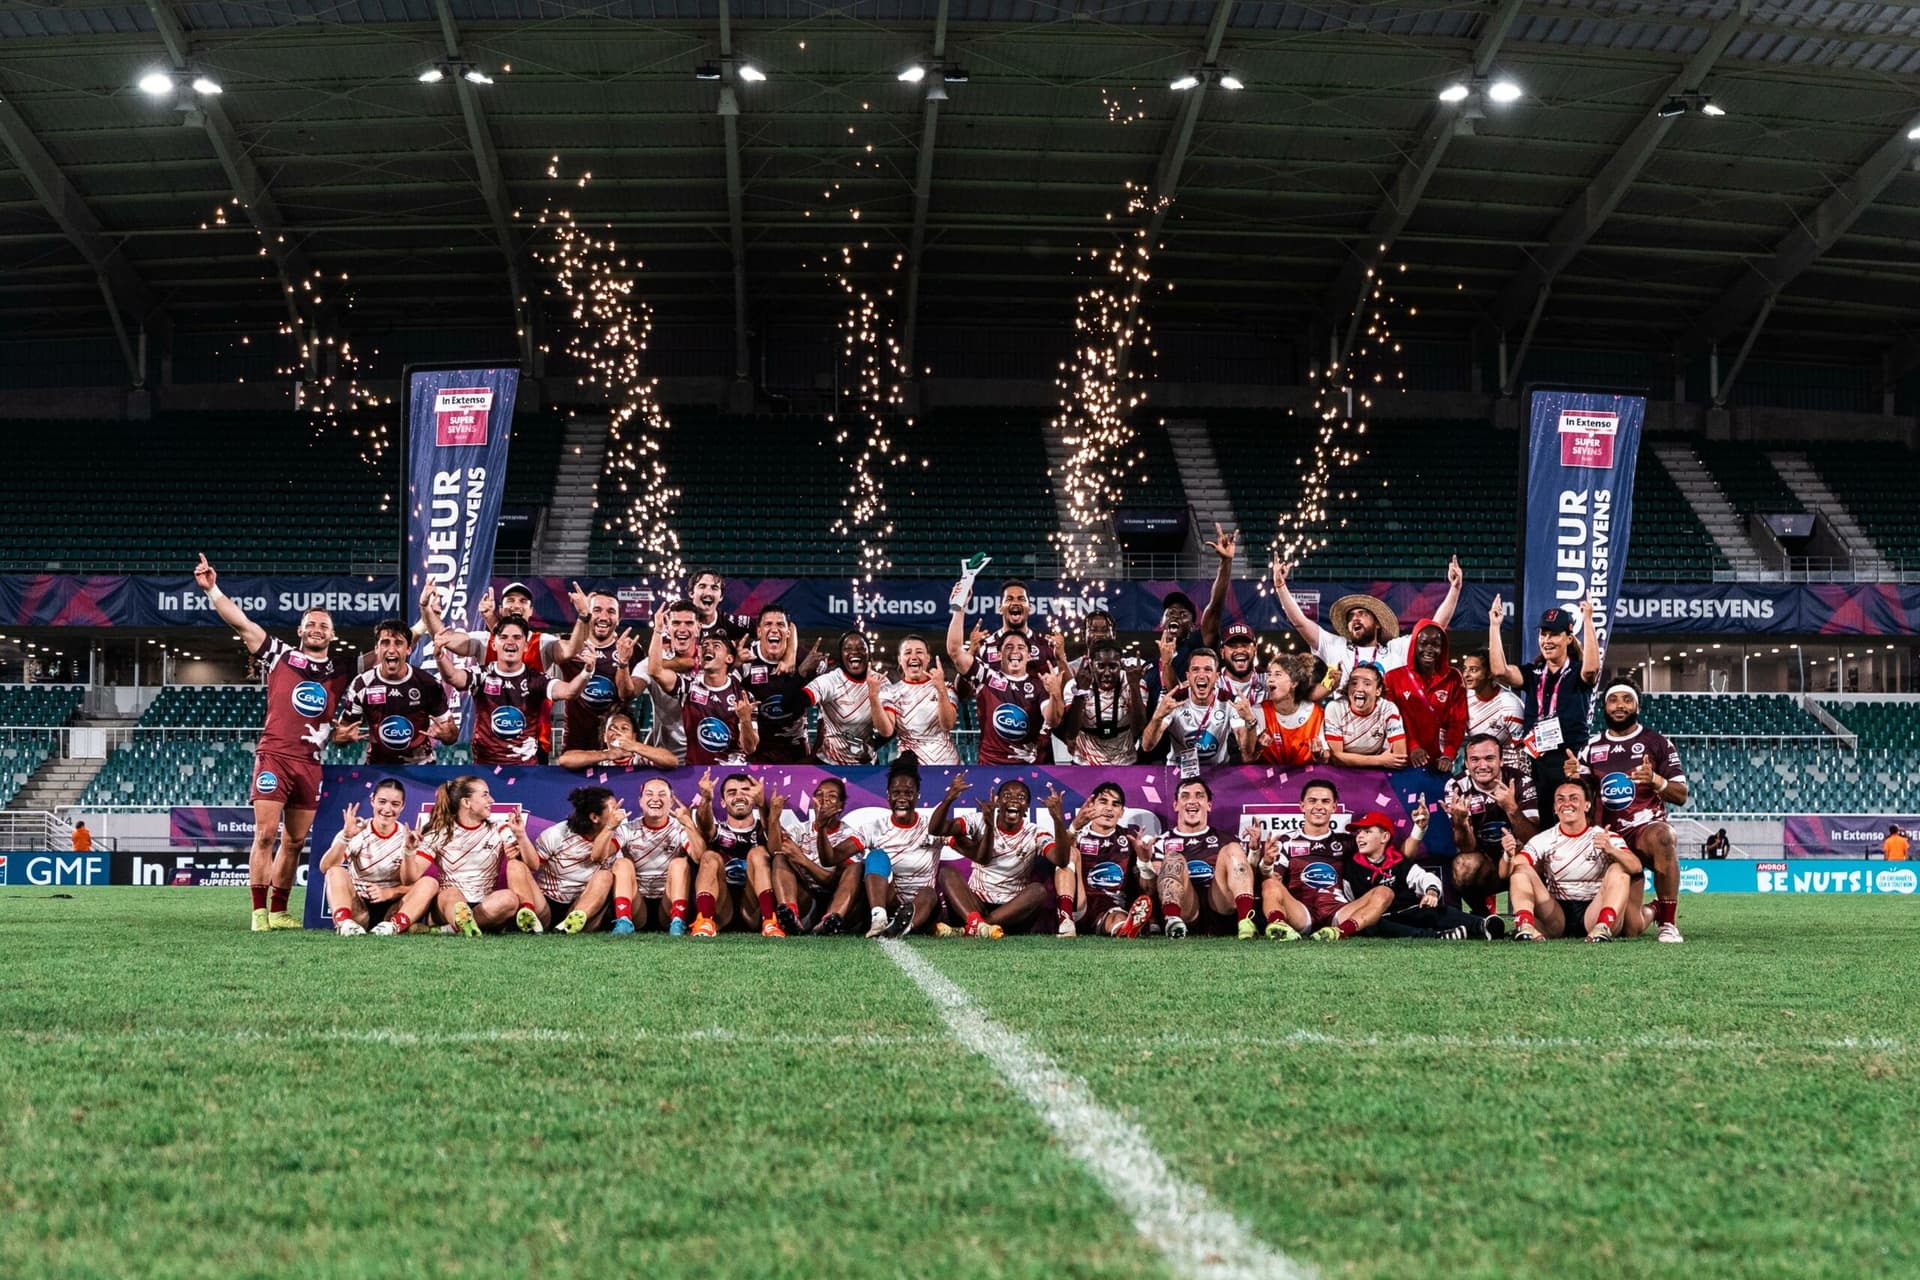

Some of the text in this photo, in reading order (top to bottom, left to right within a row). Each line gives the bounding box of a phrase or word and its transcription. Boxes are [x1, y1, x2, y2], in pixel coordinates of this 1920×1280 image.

[442, 396, 486, 405] In Extenso
[449, 416, 475, 425] SUPER
[1566, 418, 1612, 428] In Extenso
[1574, 438, 1601, 447] SUPER
[158, 591, 178, 611] In
[279, 592, 400, 612] SUPERSEV
[829, 595, 848, 613] In
[853, 596, 937, 614] Extenso
[1615, 598, 1775, 619] SUPERSEVENS
[1229, 625, 1248, 635] UBB
[217, 822, 228, 832] In
[1271, 817, 1338, 830] Exteo
[1831, 830, 1884, 840] In Extenso
[26, 856, 102, 886] GMF
[132, 856, 164, 886] In
[1757, 871, 1788, 892] BE
